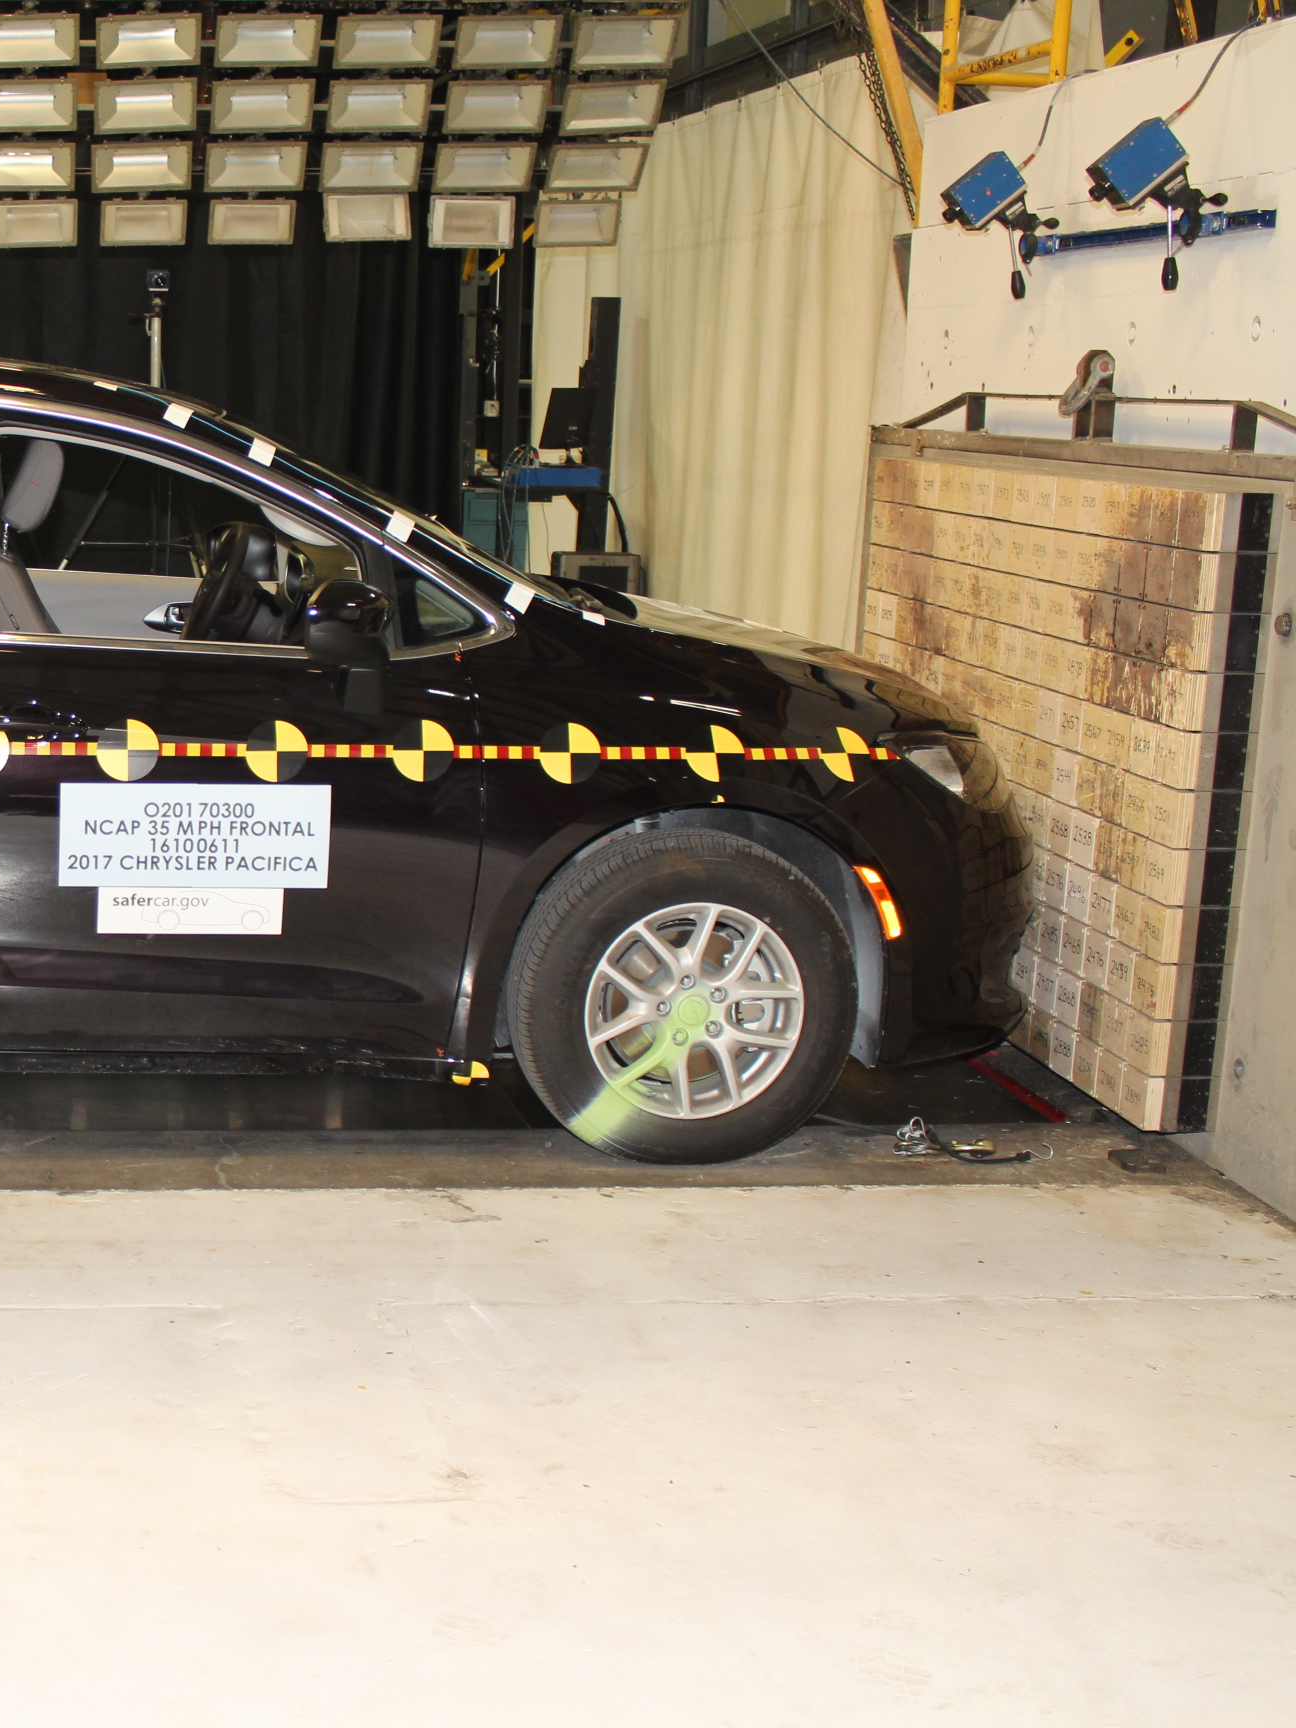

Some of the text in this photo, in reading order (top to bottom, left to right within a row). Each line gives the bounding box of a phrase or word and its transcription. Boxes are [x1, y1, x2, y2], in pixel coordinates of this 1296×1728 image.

[1039, 706, 1056, 723] 2471
[1062, 712, 1080, 732] 2457
[1084, 722, 1102, 739] 2567
[1107, 729, 1126, 748] 2454
[1154, 805, 1170, 825] 2501
[84, 819, 316, 837] NCAP 35 MPH FRONTAL
[1051, 818, 1068, 838] 2568
[1073, 825, 1092, 847] 2538
[150, 838, 240, 854] 16100611
[67, 854, 319, 872] 2017 CHRYSLER PACIFICA
[1149, 862, 1164, 884] 2569
[1045, 868, 1064, 891] 2576
[112, 892, 210, 911] safercar.gov
[1092, 892, 1112, 916] 2477
[1116, 904, 1135, 926] 2460
[1143, 920, 1160, 942] 2482
[1064, 932, 1081, 955] 2468
[1086, 946, 1104, 968] 2476
[1110, 960, 1128, 982] 2459
[1058, 985, 1076, 1008] 2868
[1137, 977, 1155, 998] 2475
